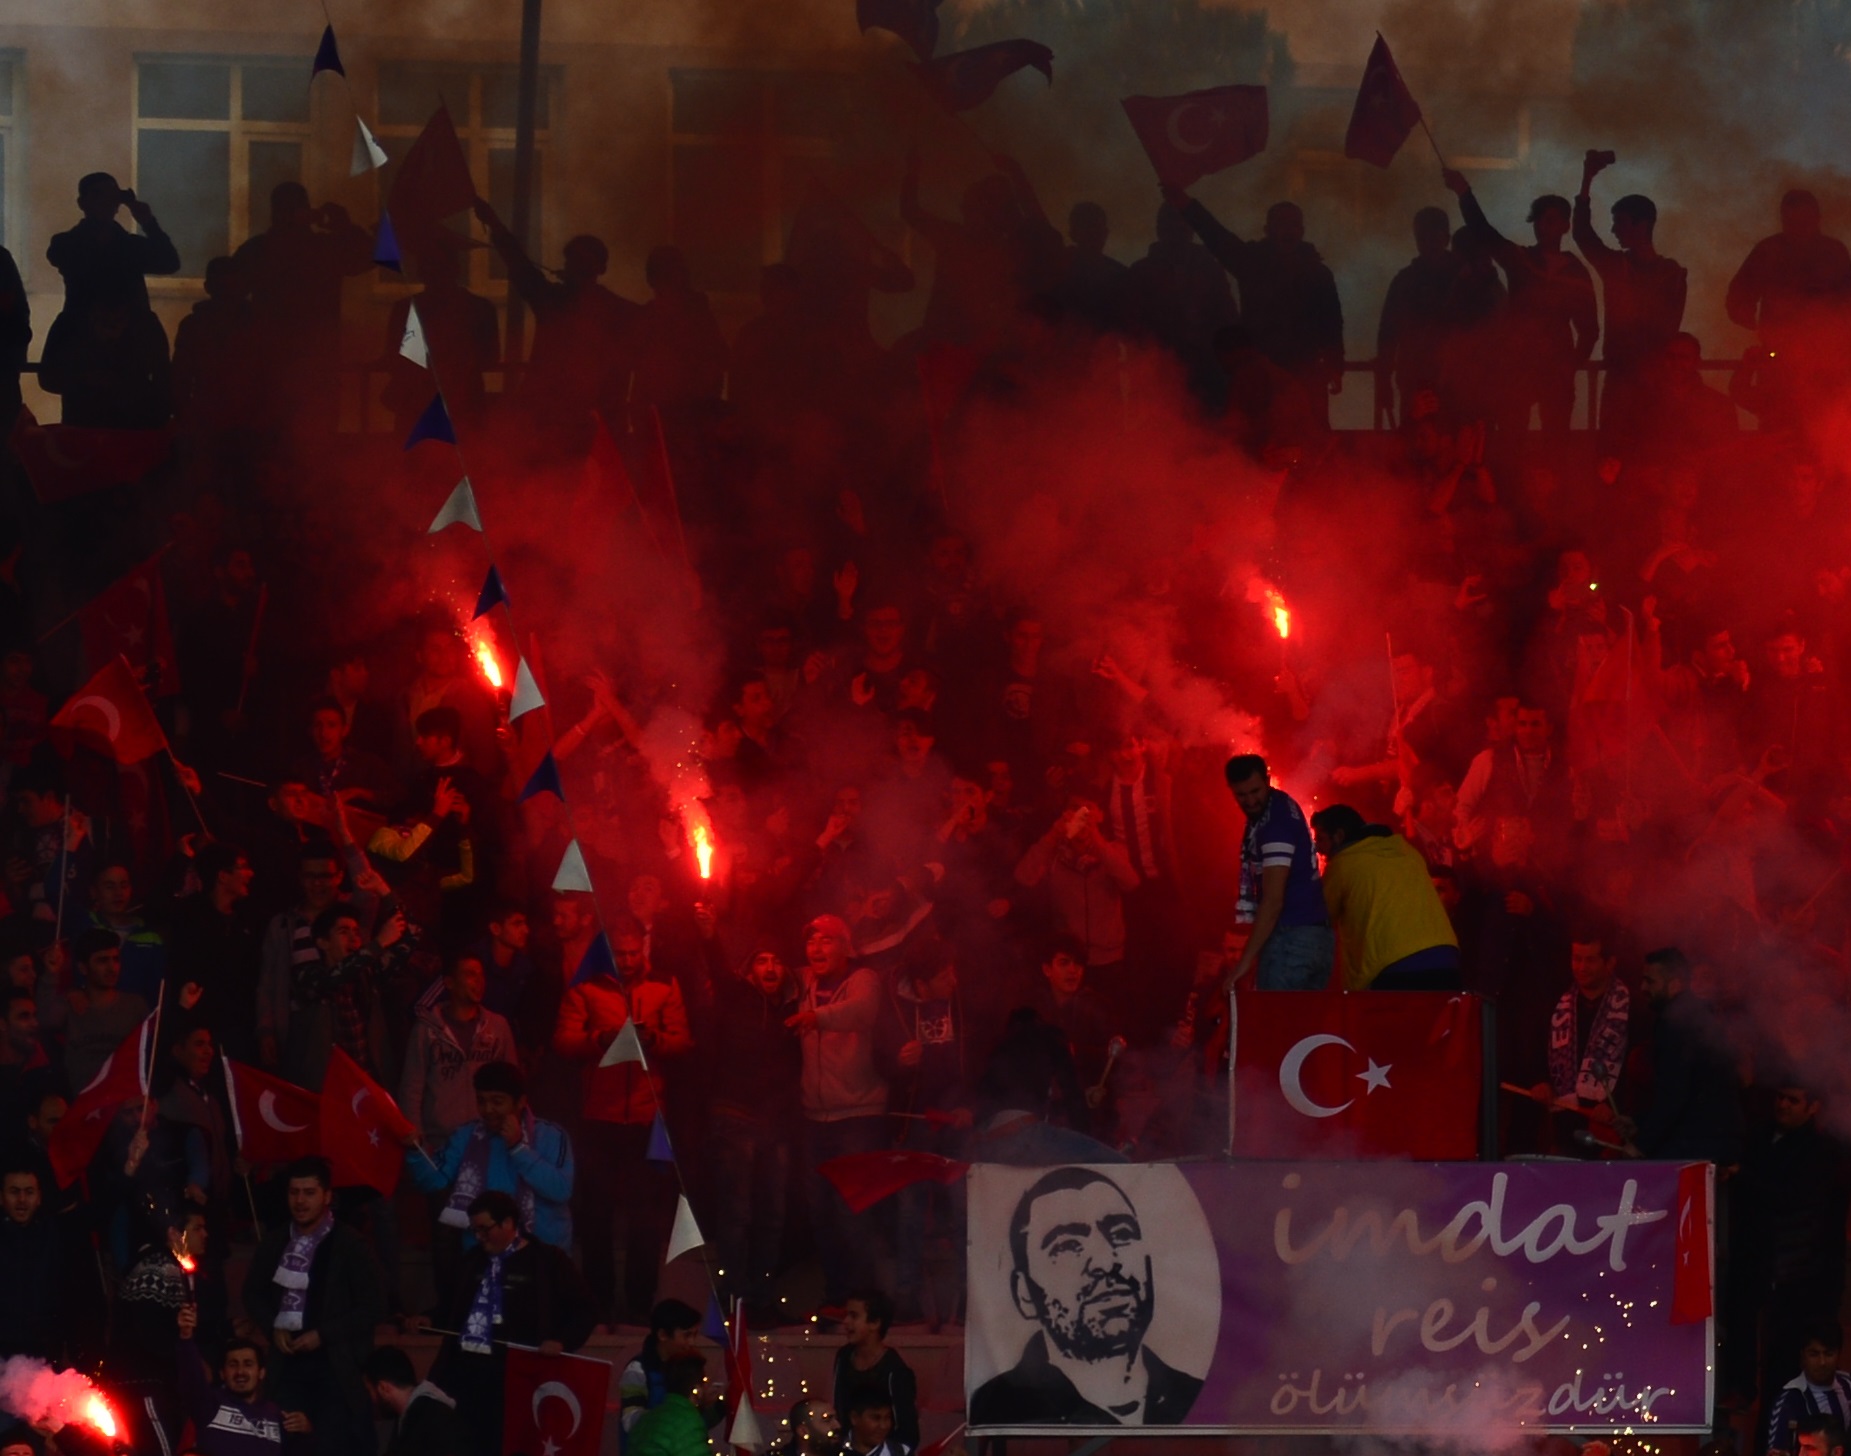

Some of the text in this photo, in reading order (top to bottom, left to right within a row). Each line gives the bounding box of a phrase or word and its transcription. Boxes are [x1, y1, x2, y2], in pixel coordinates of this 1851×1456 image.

[1273, 1171, 1668, 1273] imdat
[1371, 1277, 1569, 1363] reis
[1270, 1368, 1671, 1417] ölüszdür
